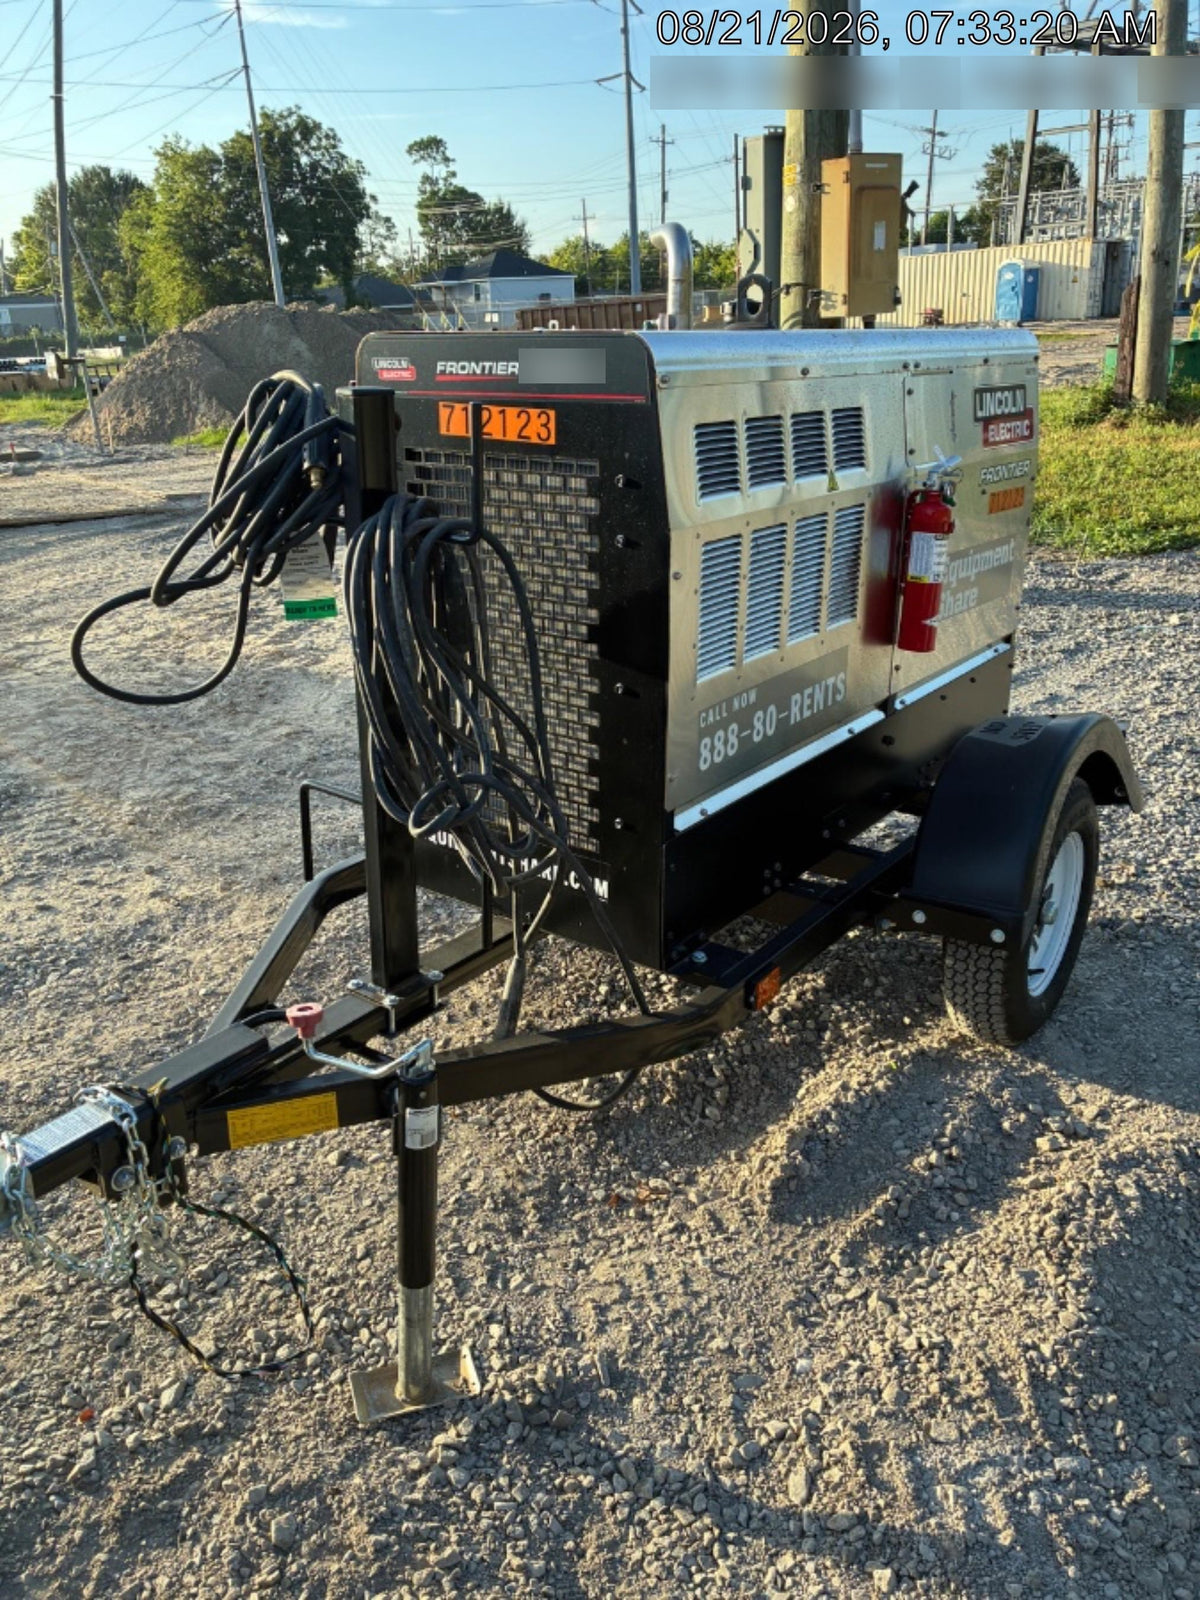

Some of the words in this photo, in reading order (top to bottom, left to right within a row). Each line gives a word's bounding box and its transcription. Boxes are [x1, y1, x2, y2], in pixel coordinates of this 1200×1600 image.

[436, 361, 519, 375] FRONTIER
[976, 388, 1025, 418] LINCOLN
[442, 404, 551, 442] 712123
[988, 419, 1031, 442] ELECTRIC
[944, 538, 1014, 587] quipment
[699, 671, 846, 771] 888-80-RENTS
[700, 702, 728, 728] CALL
[732, 687, 758, 712] NOW
